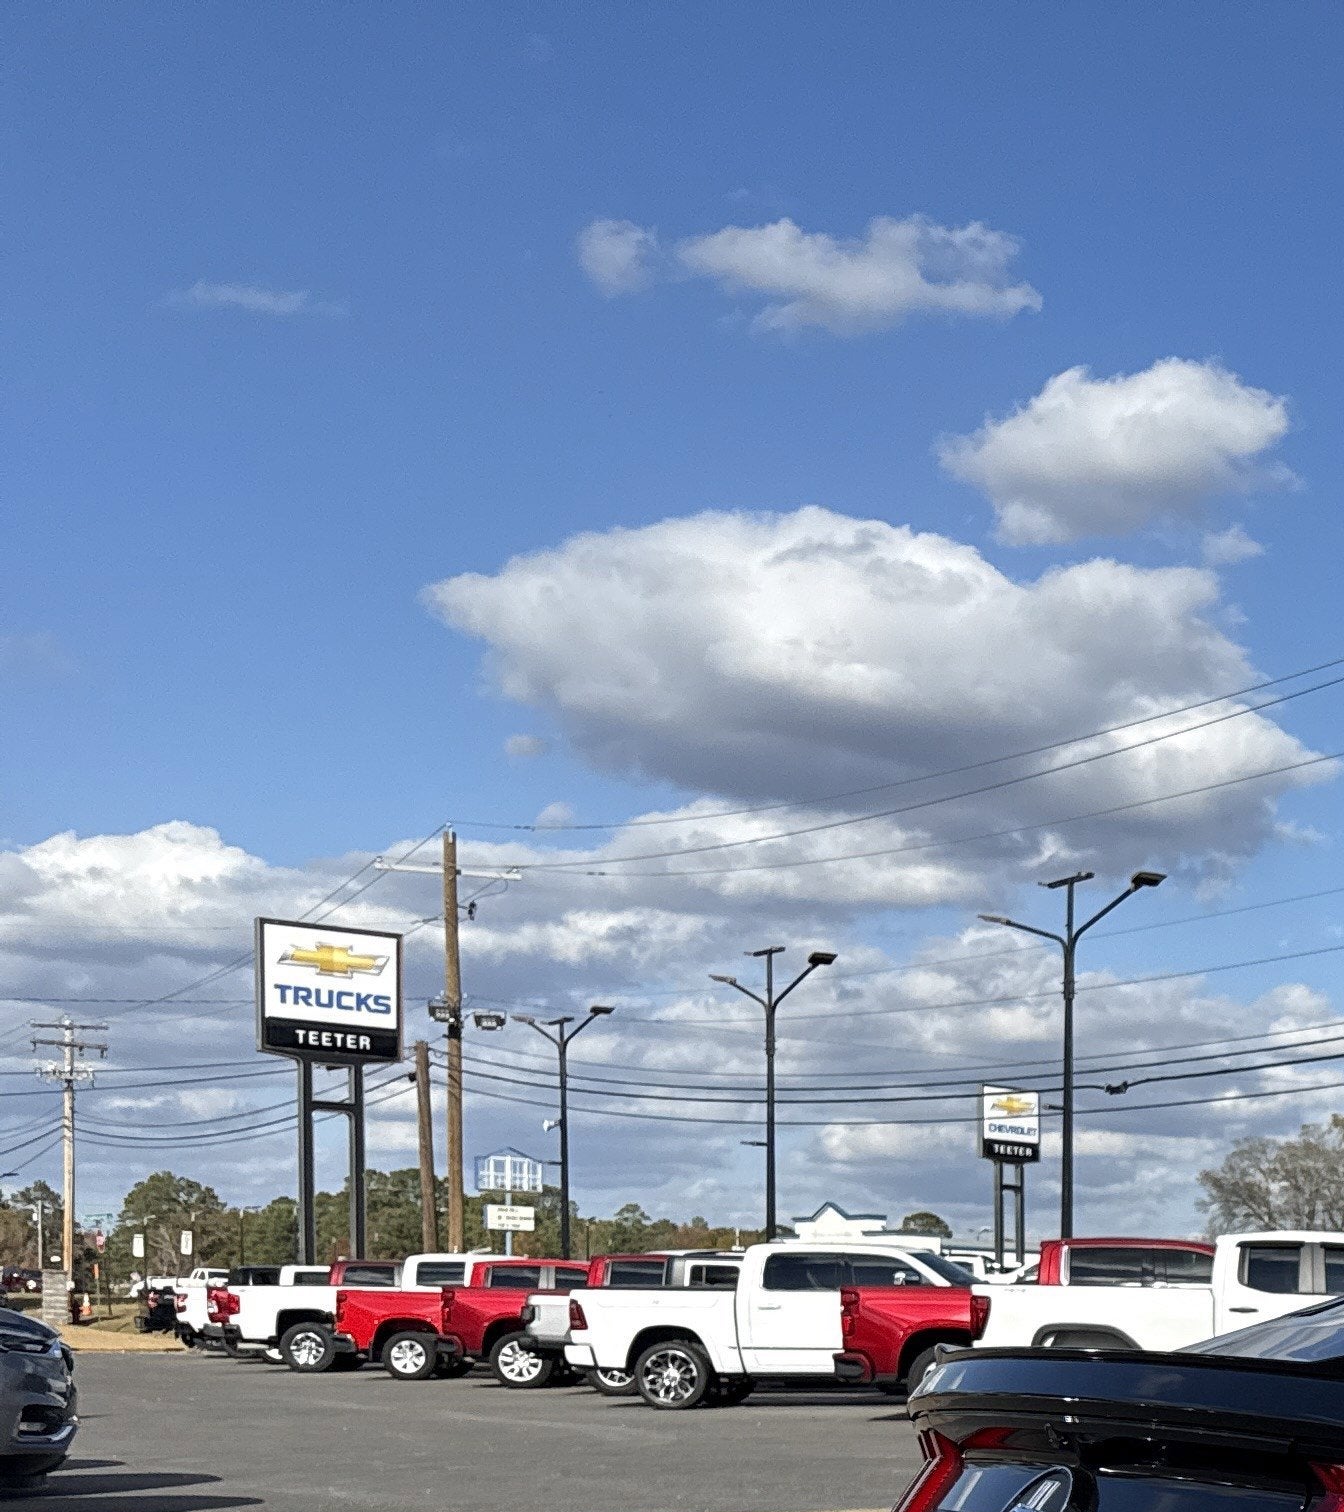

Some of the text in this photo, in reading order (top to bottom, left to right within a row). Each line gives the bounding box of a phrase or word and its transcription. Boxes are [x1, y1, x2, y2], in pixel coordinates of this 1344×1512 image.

[274, 983, 391, 1014] TRUCKS
[295, 1029, 371, 1050] TEETER
[989, 1123, 1038, 1136] CHEVROLET
[993, 1143, 1033, 1157] TEETER
